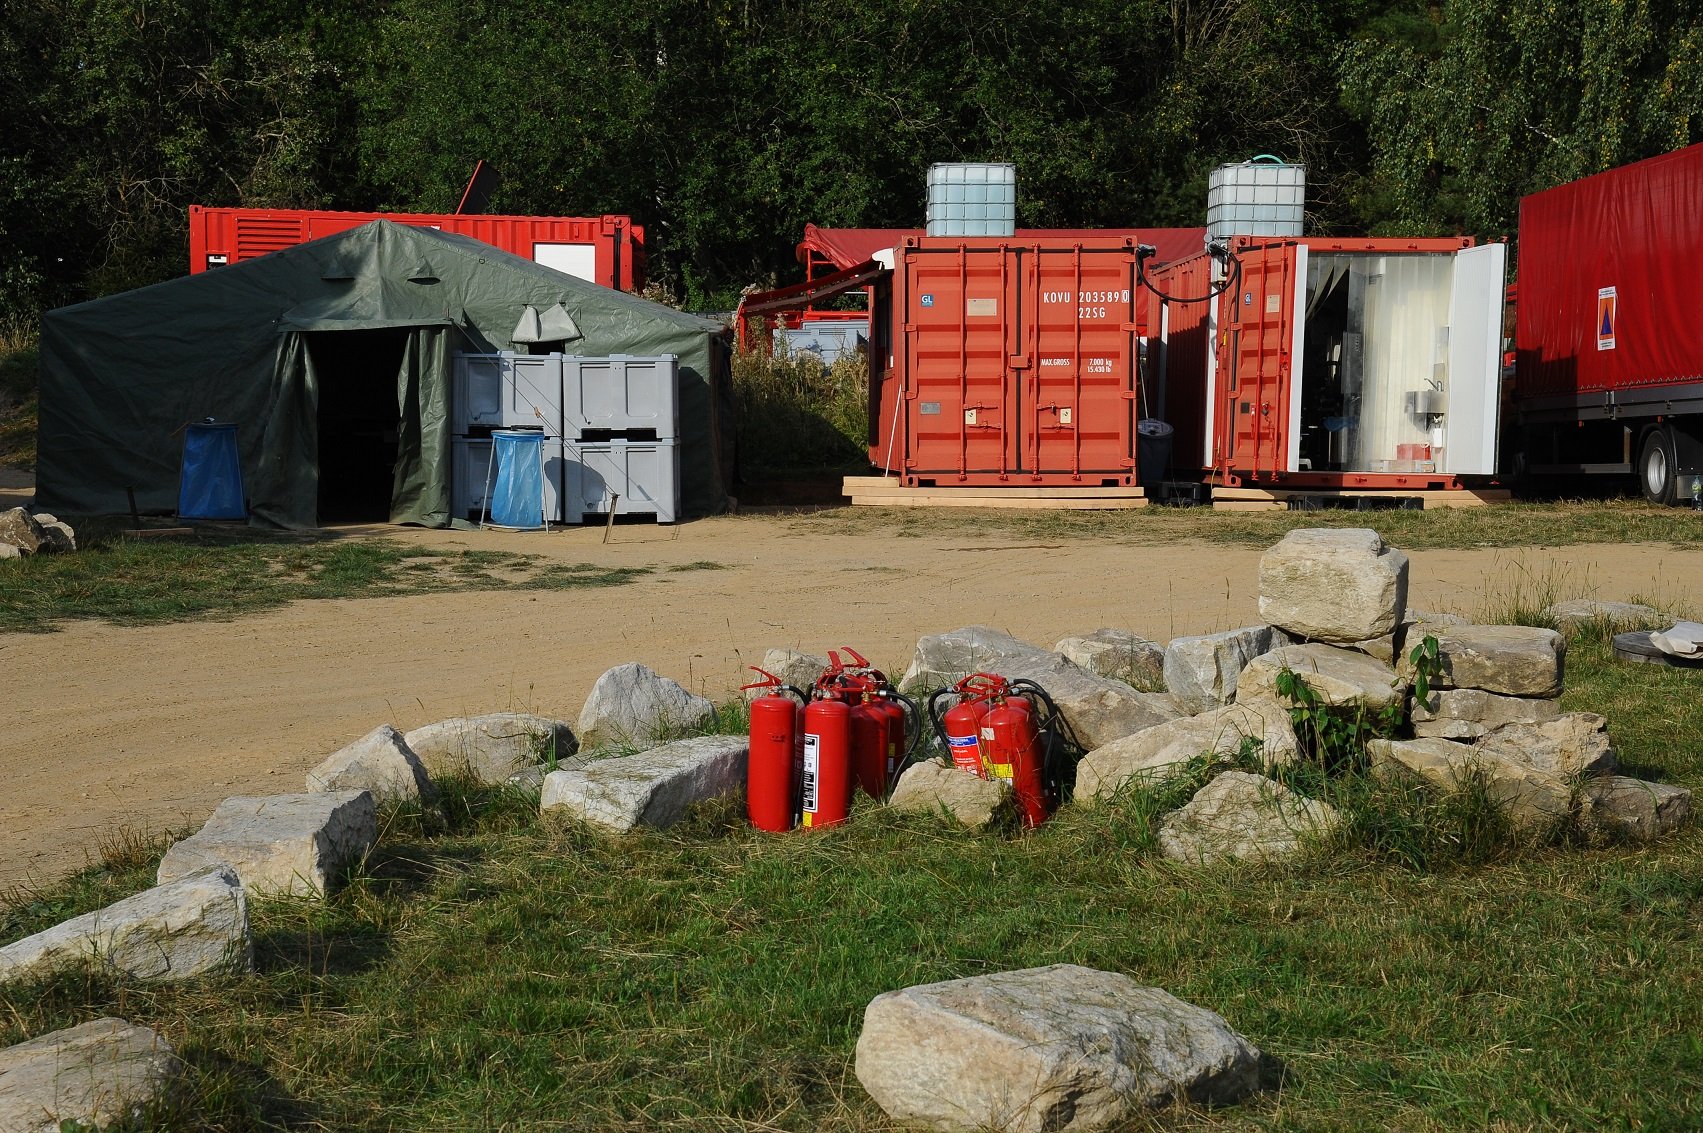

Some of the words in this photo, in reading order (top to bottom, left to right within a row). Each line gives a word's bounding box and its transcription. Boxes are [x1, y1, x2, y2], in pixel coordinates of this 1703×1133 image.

[921, 295, 933, 303] GL
[1043, 292, 1070, 303] KOVU
[1079, 307, 1105, 318] 22SG
[1105, 359, 1112, 367] kg
